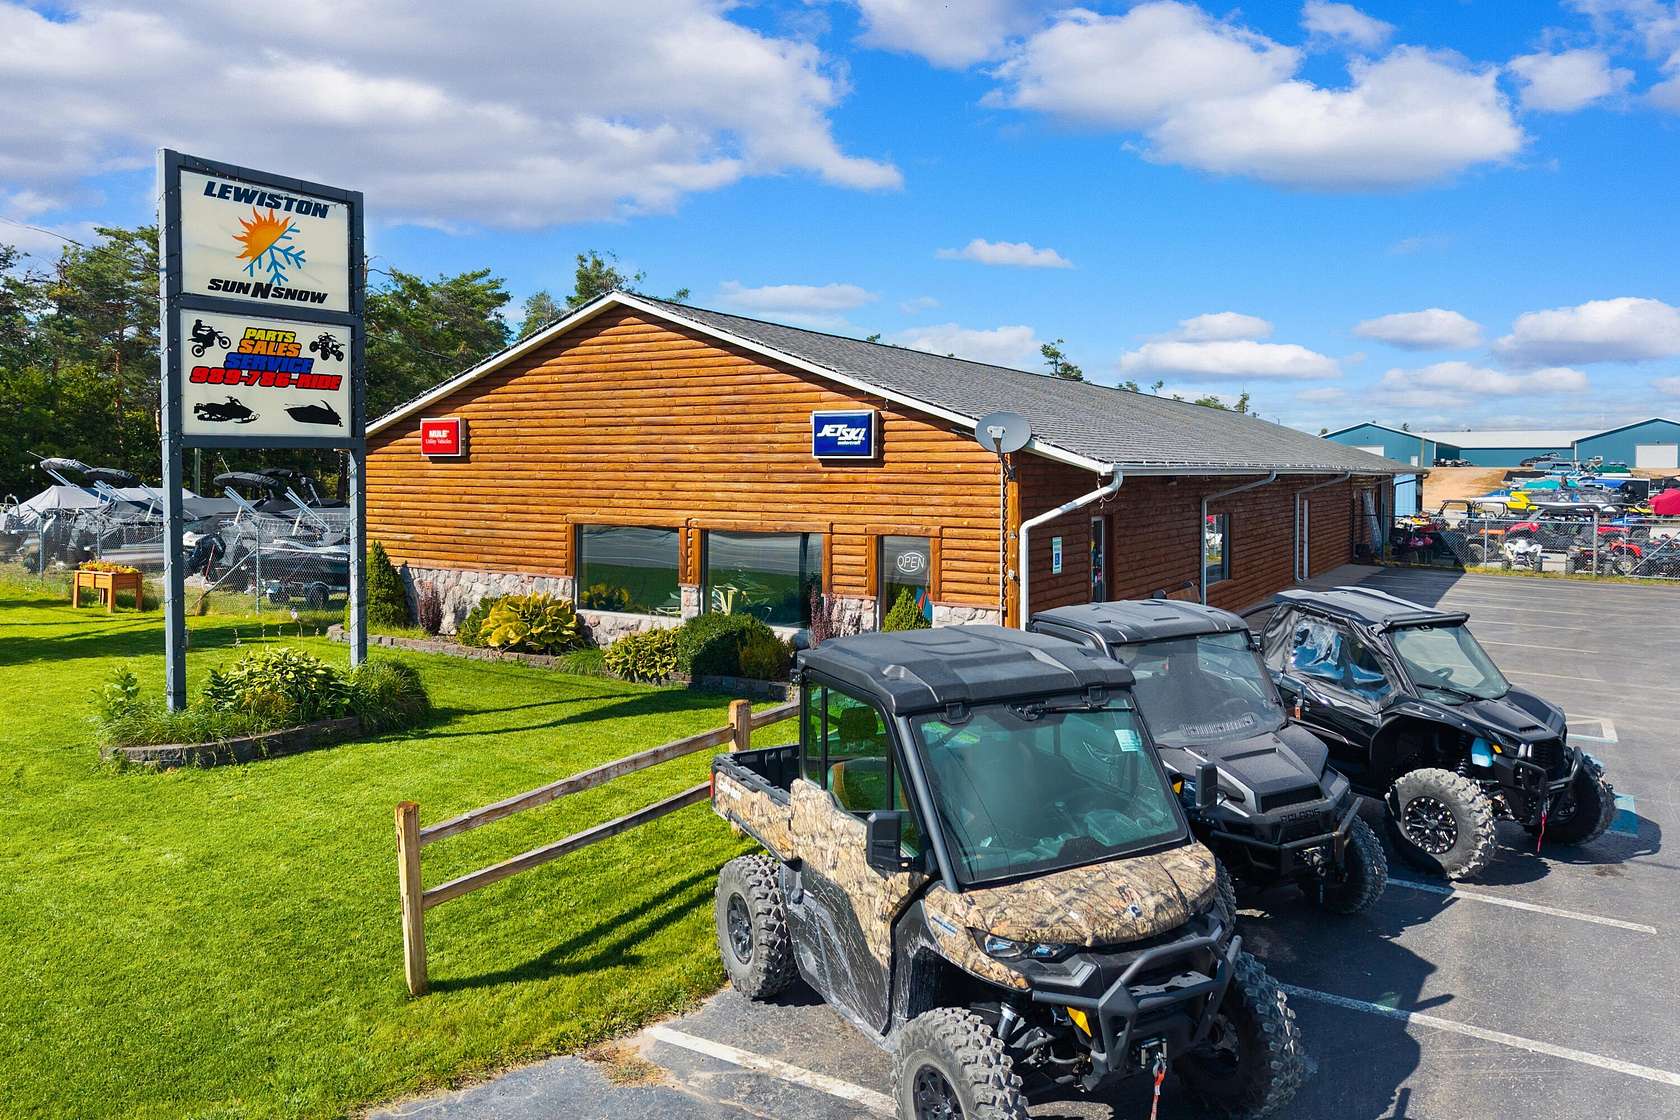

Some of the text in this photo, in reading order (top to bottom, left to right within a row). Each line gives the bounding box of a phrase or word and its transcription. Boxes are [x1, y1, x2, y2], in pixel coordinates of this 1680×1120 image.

[204, 181, 329, 218] LEWISTON
[208, 278, 328, 304] SUN N SNOW
[244, 327, 296, 343] PARTS
[238, 339, 302, 357] SALES
[223, 352, 314, 374] SERVICE
[816, 424, 848, 437] JET
[897, 555, 925, 569] OPEN
